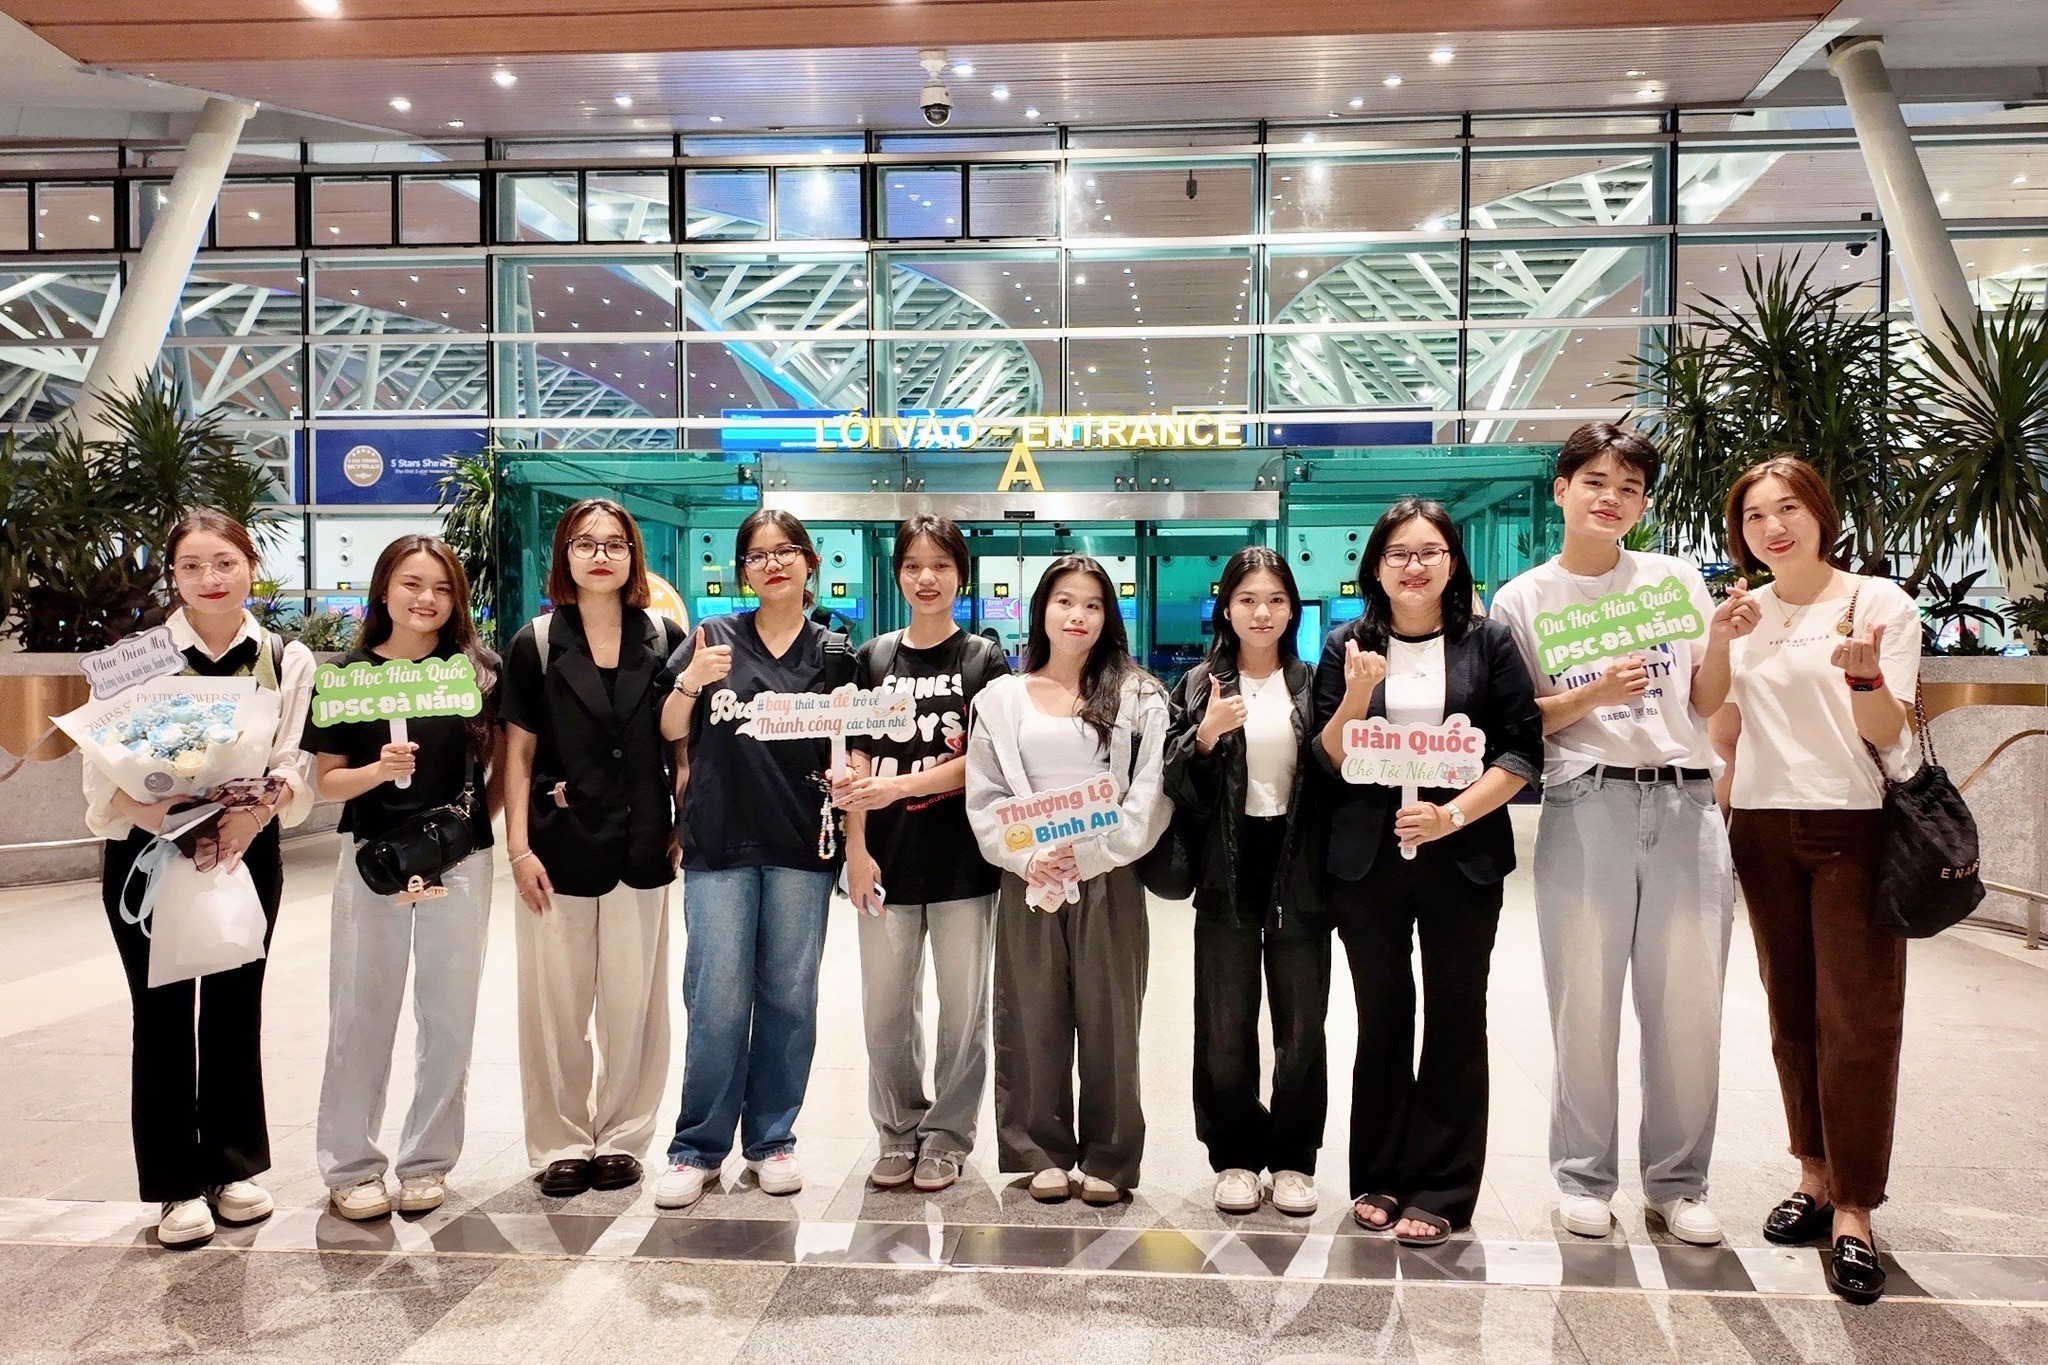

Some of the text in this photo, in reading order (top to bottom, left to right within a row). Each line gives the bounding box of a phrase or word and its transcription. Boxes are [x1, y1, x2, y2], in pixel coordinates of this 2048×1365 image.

[814, 406, 881, 450] LỐI
[892, 408, 980, 450] VÀO
[1021, 413, 1244, 448] ENTRANCE
[390, 459, 397, 467] 5
[398, 458, 421, 468] Stars
[997, 443, 1045, 491] A
[1540, 582, 1682, 637] Du Học Hàn Quốc
[1599, 626, 1635, 651] Đà
[1635, 610, 1698, 643] Nẵng
[320, 659, 468, 689] Du Học Hàn Quốc
[377, 691, 411, 714] Đà
[415, 685, 475, 711] Nẵng
[757, 717, 805, 735] Thành
[808, 715, 843, 736] công
[846, 718, 864, 730] các
[1351, 722, 1476, 755] Hàn Quốc
[1380, 759, 1401, 779] Tôi
[996, 778, 1114, 825] Thượng Lộ
[1035, 809, 1119, 843] Bình An
